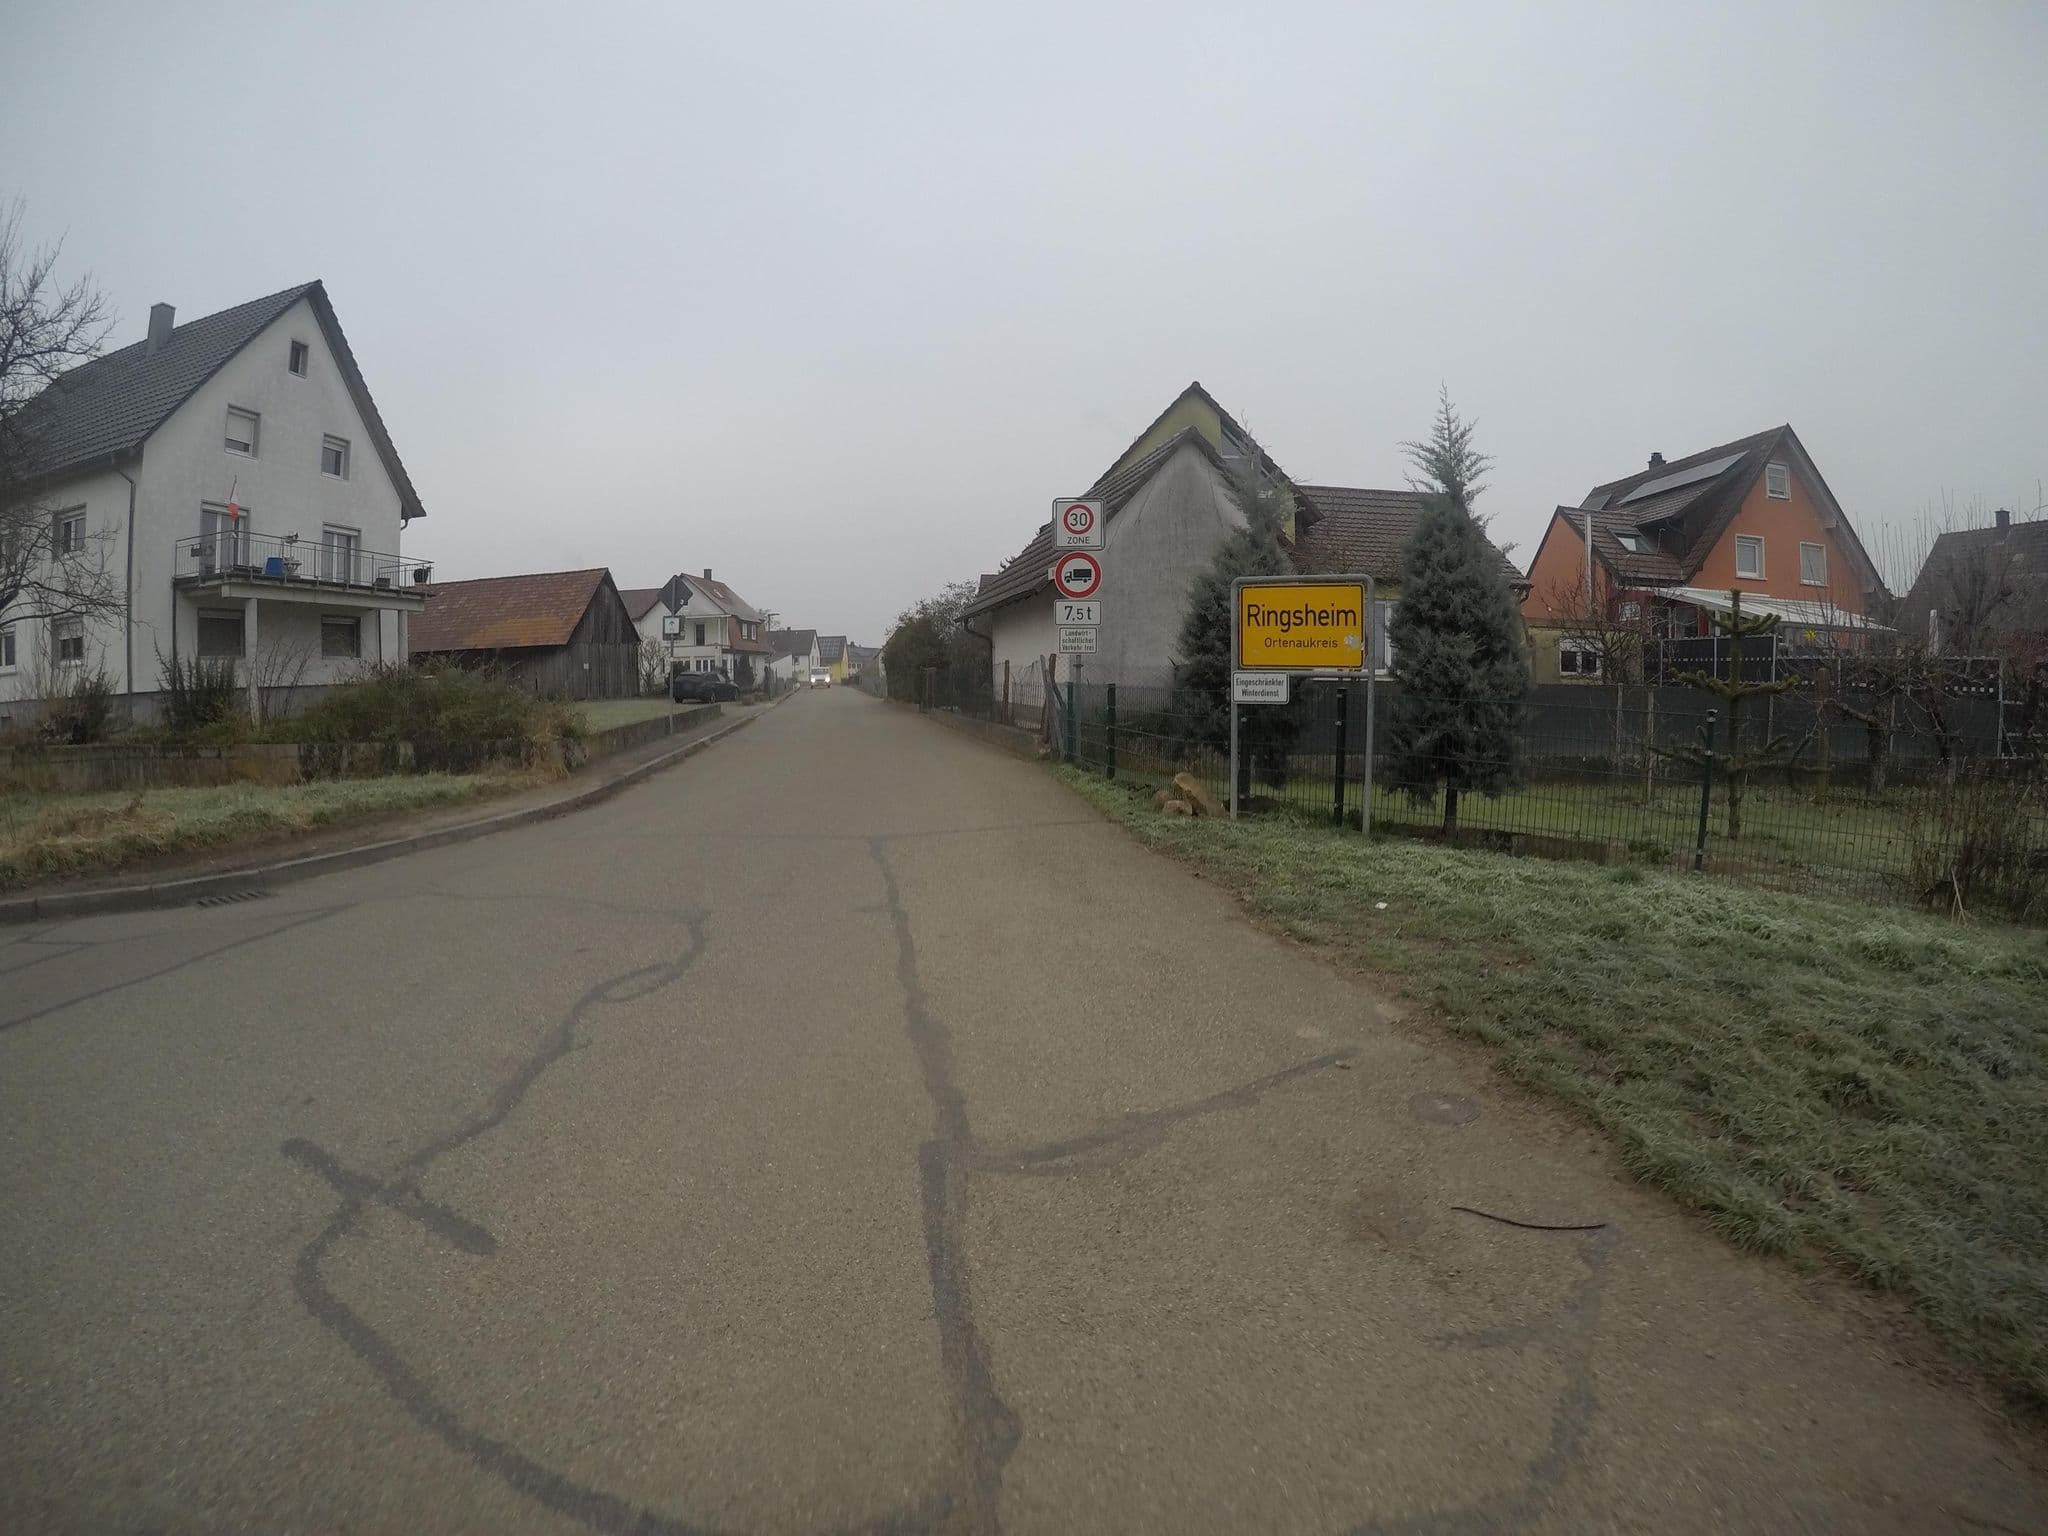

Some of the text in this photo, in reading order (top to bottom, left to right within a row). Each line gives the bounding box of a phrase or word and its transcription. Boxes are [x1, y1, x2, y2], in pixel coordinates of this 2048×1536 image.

[1069, 512, 1088, 527] 30
[1067, 536, 1091, 545] ZONE
[1246, 602, 1357, 633] Ringsheim
[1264, 637, 1339, 648] Ortenaukreis
[1235, 678, 1284, 687] Eingeschränkter
[1241, 688, 1280, 697] Winterdienst
